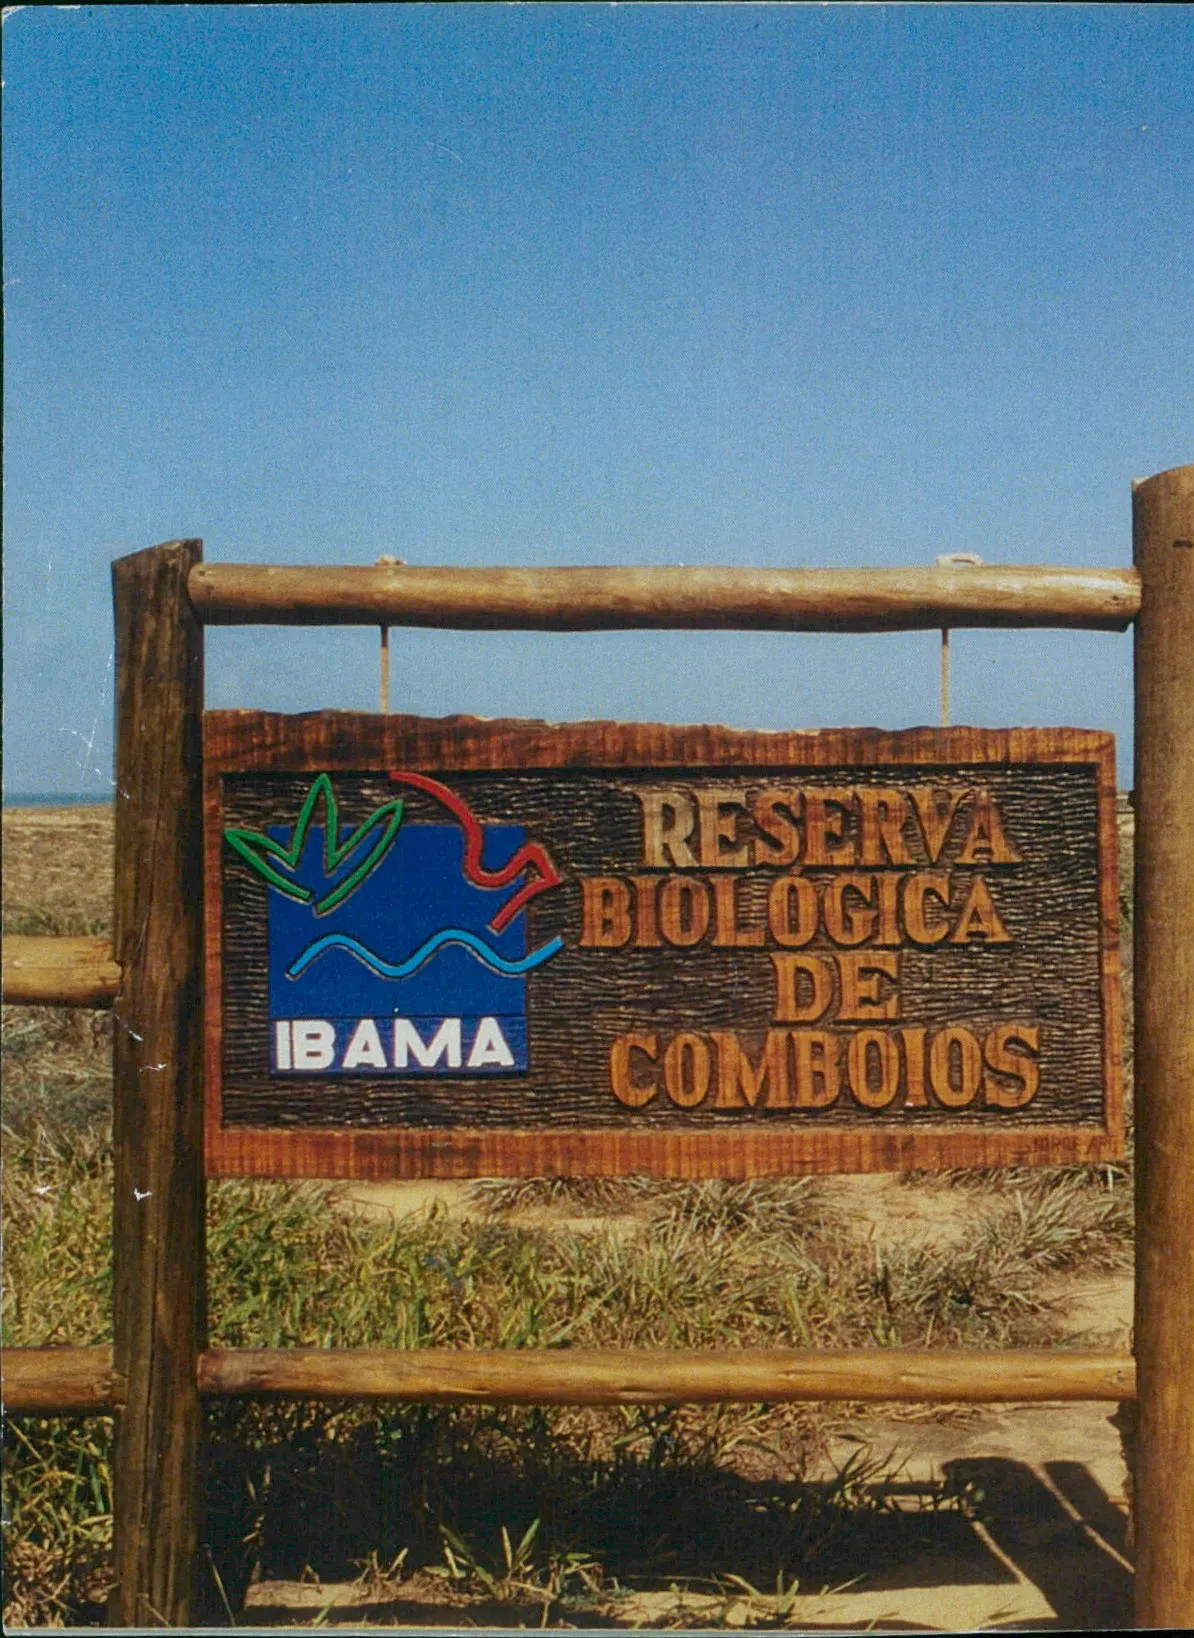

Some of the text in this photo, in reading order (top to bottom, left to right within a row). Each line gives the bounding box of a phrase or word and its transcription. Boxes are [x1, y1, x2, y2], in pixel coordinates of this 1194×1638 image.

[636, 788, 1022, 868] RESERVA
[769, 953, 900, 1022] DE
[275, 1016, 515, 1070] IBAMA
[610, 1025, 1041, 1109] COMBOIOS
